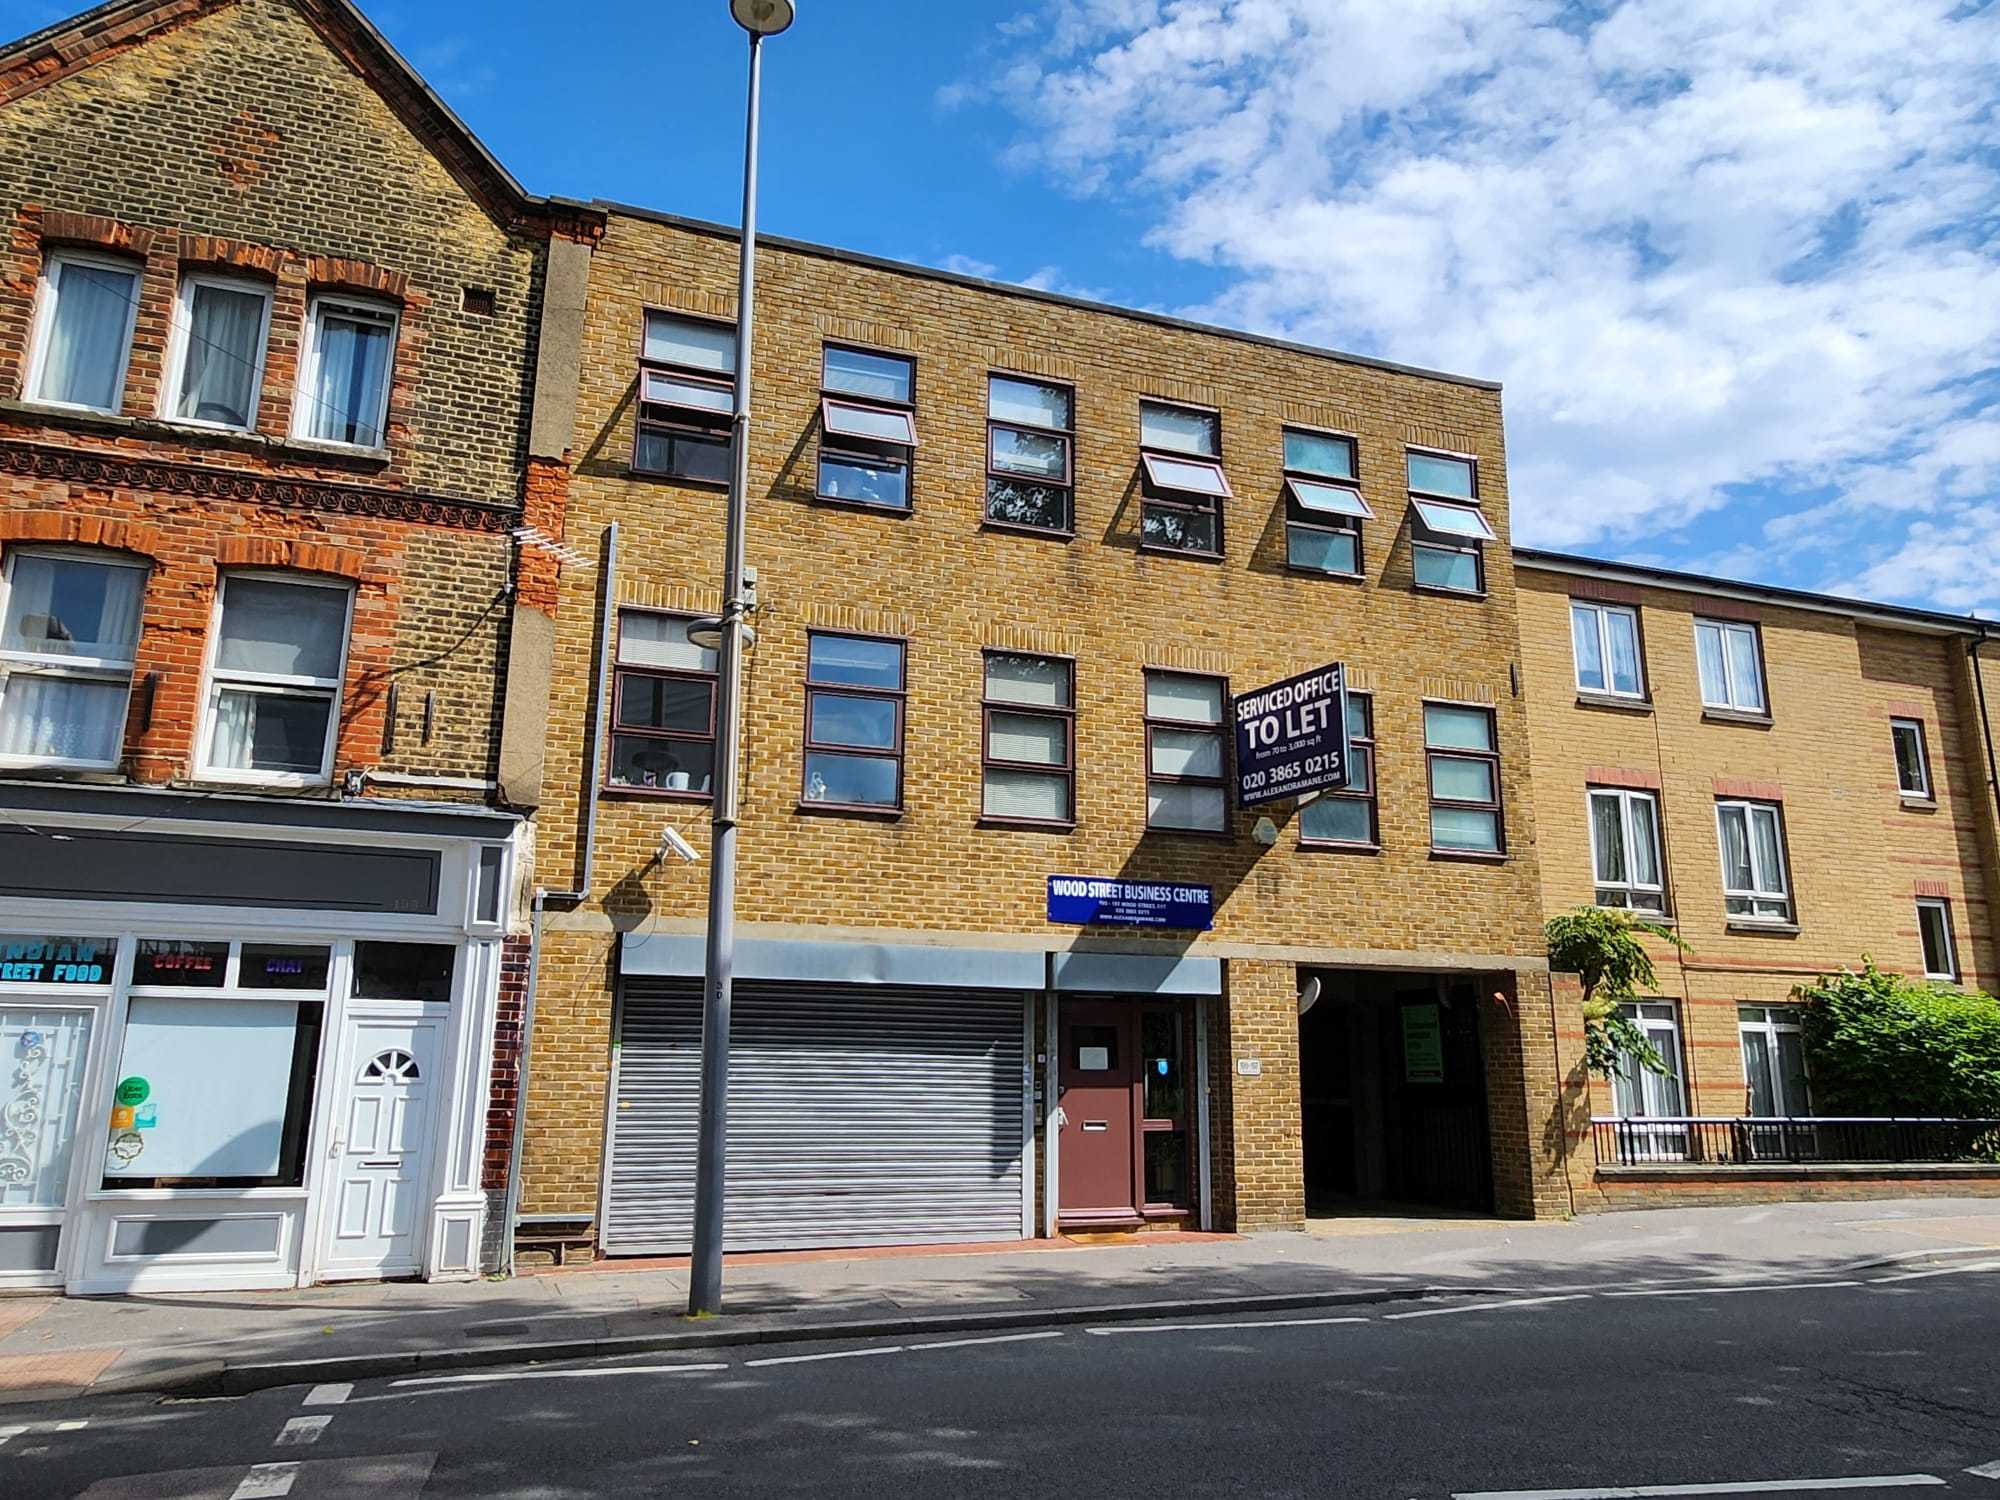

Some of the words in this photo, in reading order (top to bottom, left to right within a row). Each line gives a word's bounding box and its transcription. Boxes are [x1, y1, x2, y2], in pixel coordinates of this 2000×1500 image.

[1237, 685, 1293, 722] SERVICED
[1294, 670, 1340, 704] OFFICE
[1244, 715, 1280, 750] TO
[1285, 698, 1332, 739] LET
[1256, 747, 1271, 760] from
[1272, 744, 1279, 755] 70
[1280, 745, 1287, 754] to
[1307, 739, 1316, 750] sq
[1315, 734, 1322, 745] ft
[1243, 771, 1266, 790] 020
[1269, 761, 1301, 783] 3865
[1305, 751, 1340, 774] 0215
[1243, 771, 1341, 802] WWW.ALEXANDRAMANE.COM
[1053, 879, 1088, 897] WOOD
[1088, 882, 1123, 899] STREET
[1124, 884, 1172, 902] BUSINESS
[1173, 887, 1209, 904] CENTRE
[52, 964, 103, 982] FOOD
[153, 955, 215, 971] COFFEE
